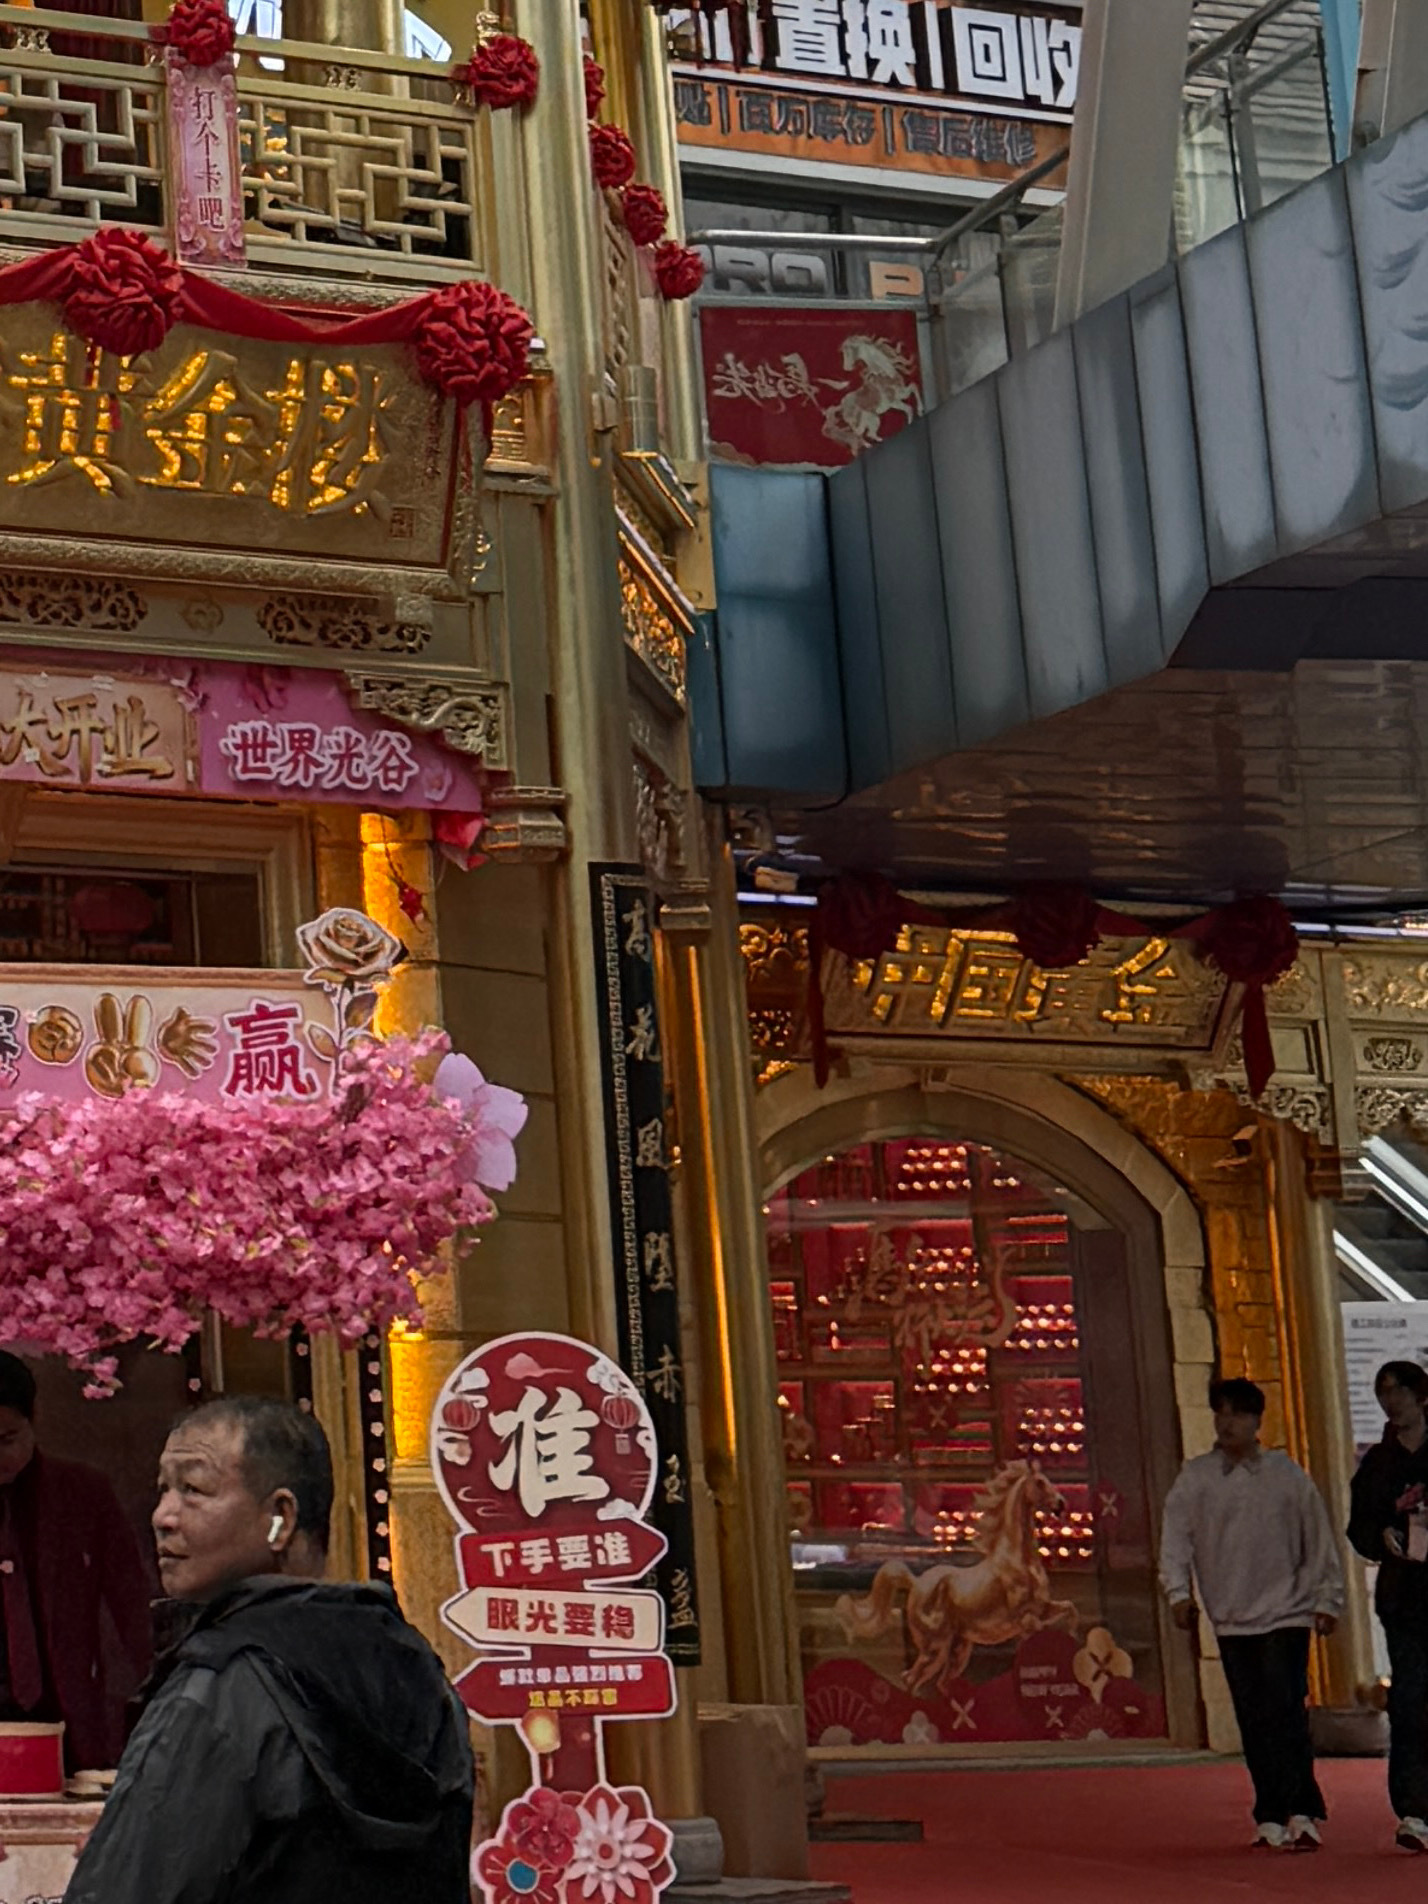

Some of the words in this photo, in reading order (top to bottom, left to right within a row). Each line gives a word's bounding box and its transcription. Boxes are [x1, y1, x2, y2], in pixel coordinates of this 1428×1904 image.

[192, 86, 226, 232] 打个卡吧
[740, 91, 876, 146] 百万库存
[900, 106, 1037, 167] 售后维修
[228, 722, 416, 790] 世界光谷
[850, 924, 1178, 1024] 中国黄金
[224, 1000, 318, 1100] 赢
[489, 1386, 610, 1517] 准
[481, 1530, 631, 1578] 下手要准
[487, 1597, 635, 1640] 眼光要稳
